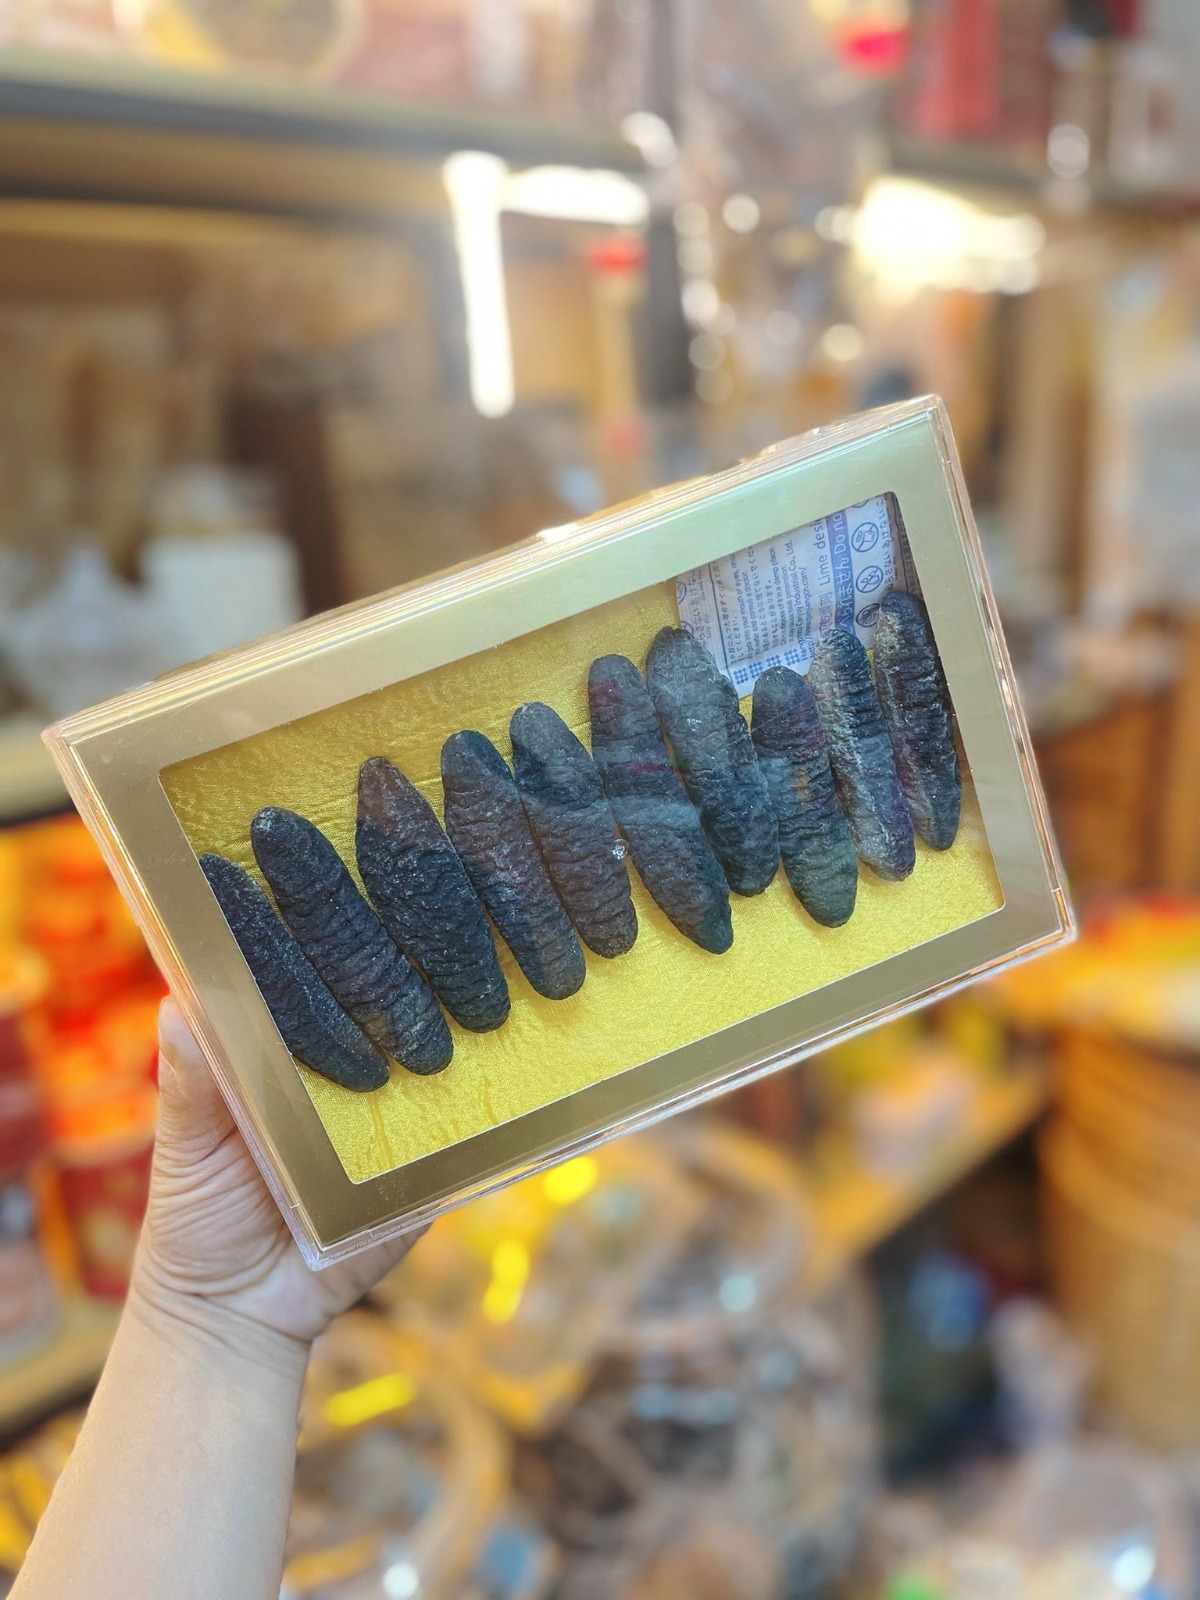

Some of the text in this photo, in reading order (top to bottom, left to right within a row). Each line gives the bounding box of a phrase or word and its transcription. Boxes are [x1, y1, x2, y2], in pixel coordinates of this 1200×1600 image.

[785, 540, 793, 555] Ltd.
[834, 534, 847, 555] Do
[772, 566, 780, 585] damp
[819, 555, 831, 587] Lime
[790, 572, 801, 606] Industrial
